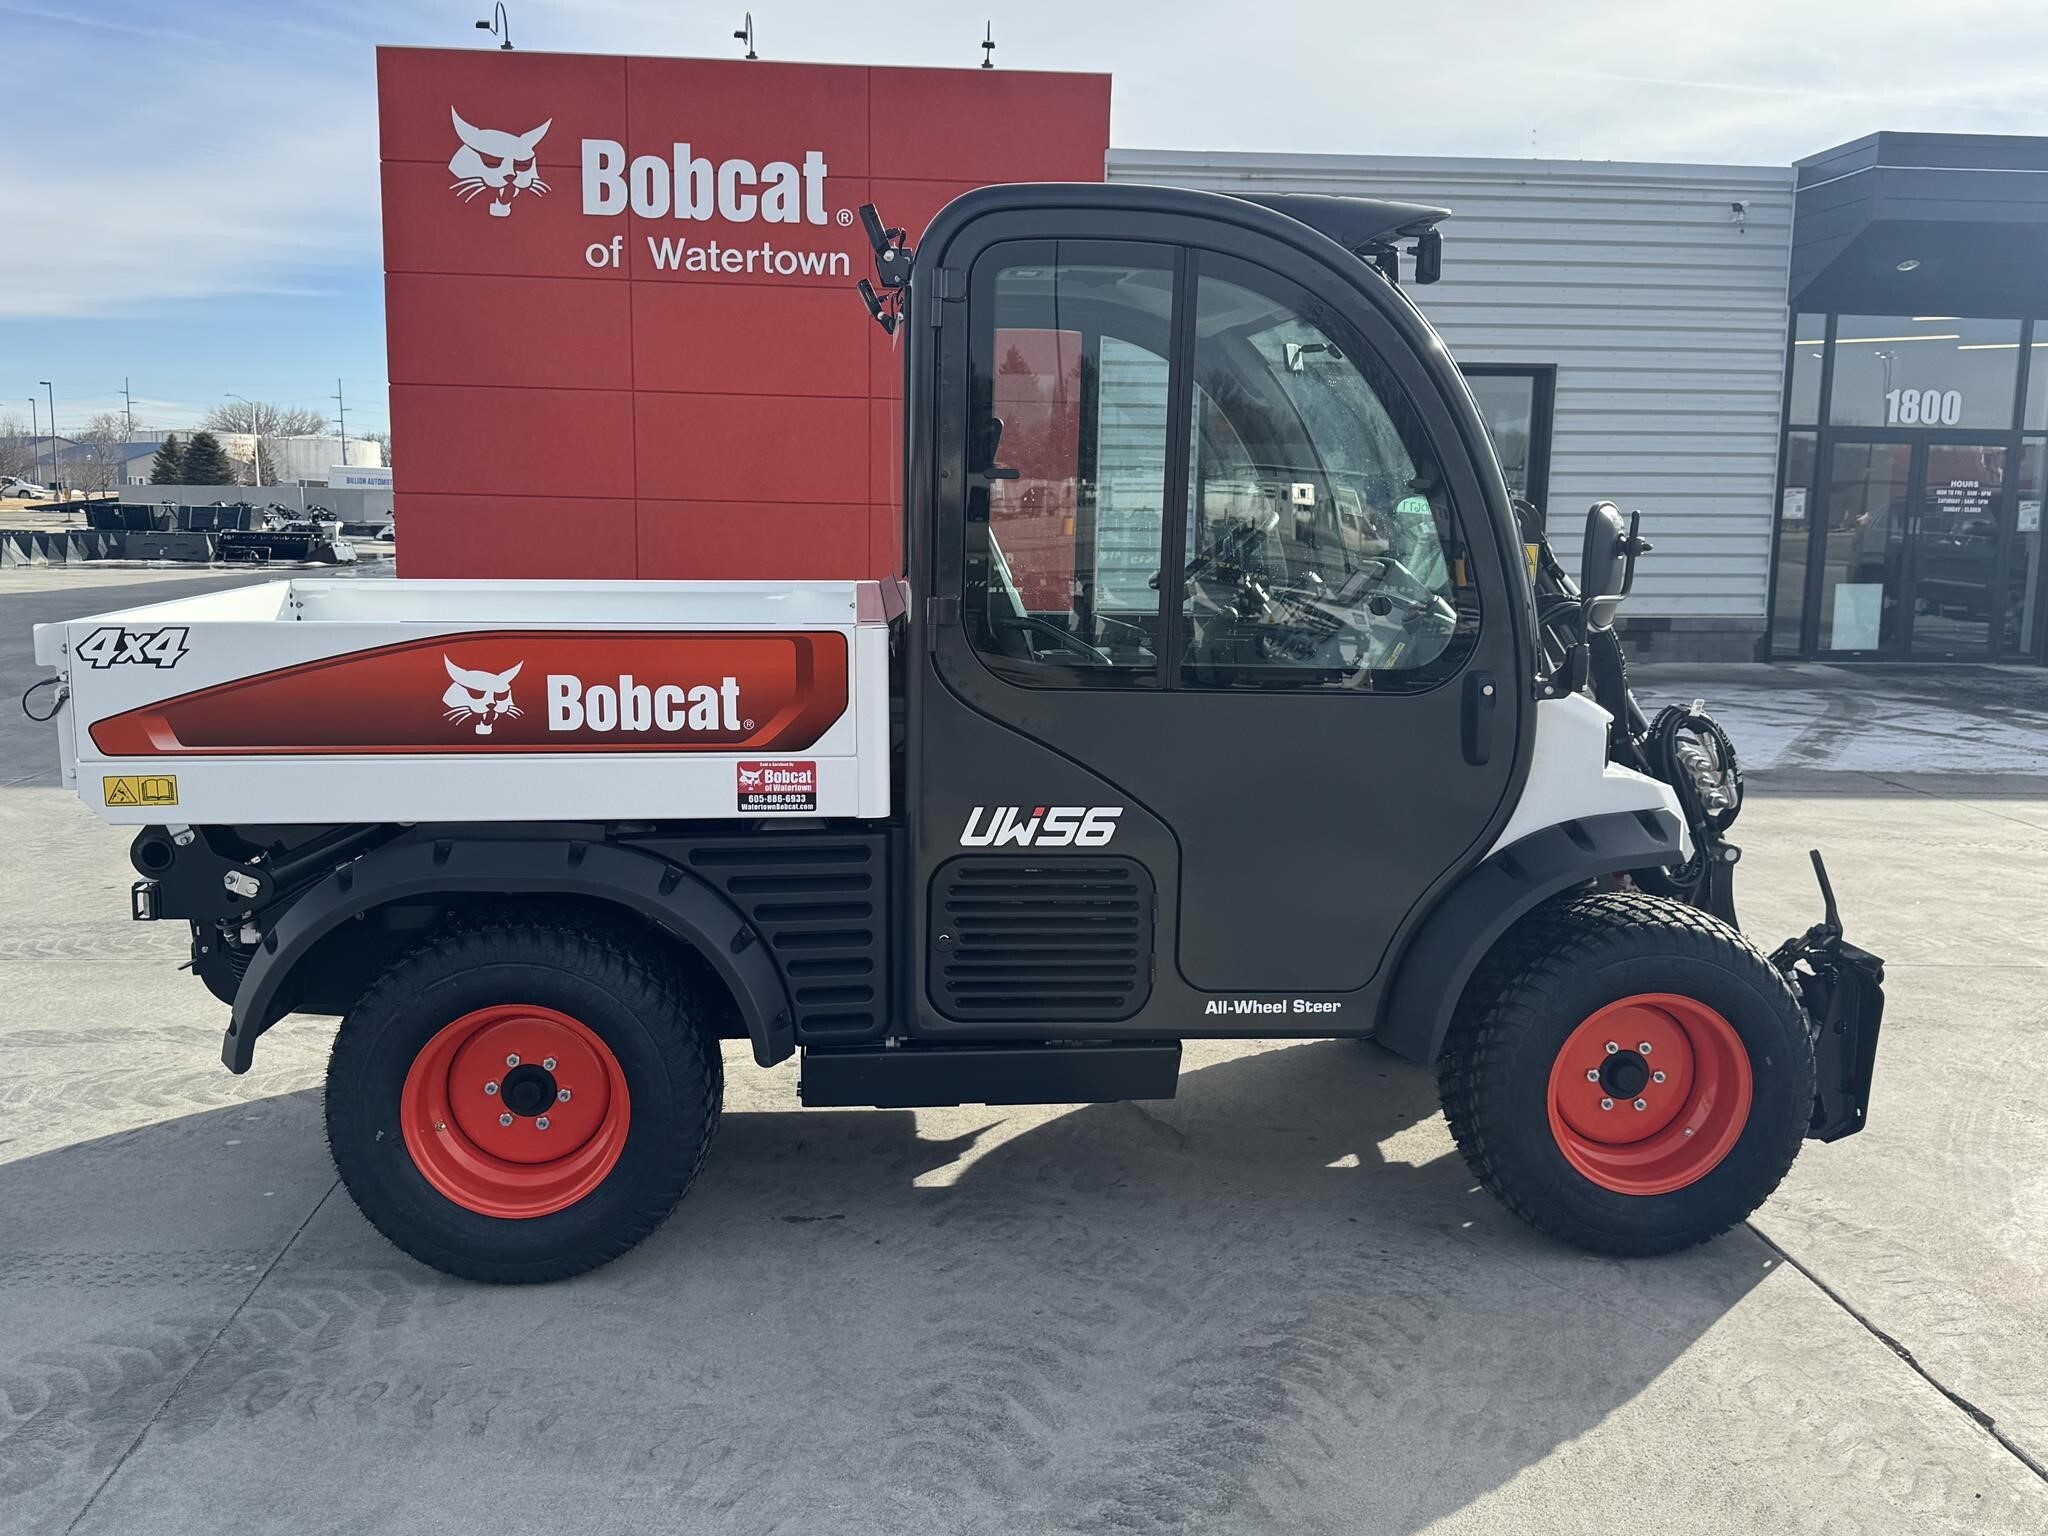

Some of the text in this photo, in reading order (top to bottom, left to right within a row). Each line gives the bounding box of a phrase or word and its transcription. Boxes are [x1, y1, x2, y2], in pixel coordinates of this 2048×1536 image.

[581, 138, 828, 225] Bobcat
[585, 235, 850, 276] of Watertown
[1885, 388, 1962, 425] 1800
[1950, 480, 1979, 488] HOURS
[76, 626, 190, 669] 4x4
[547, 674, 741, 731] Bobcat
[764, 769, 812, 784] Bobcat
[764, 784, 812, 792] of Watertown
[748, 794, 806, 803] 605-886-6933
[1204, 999, 1342, 1015] All-Wheel Steer
